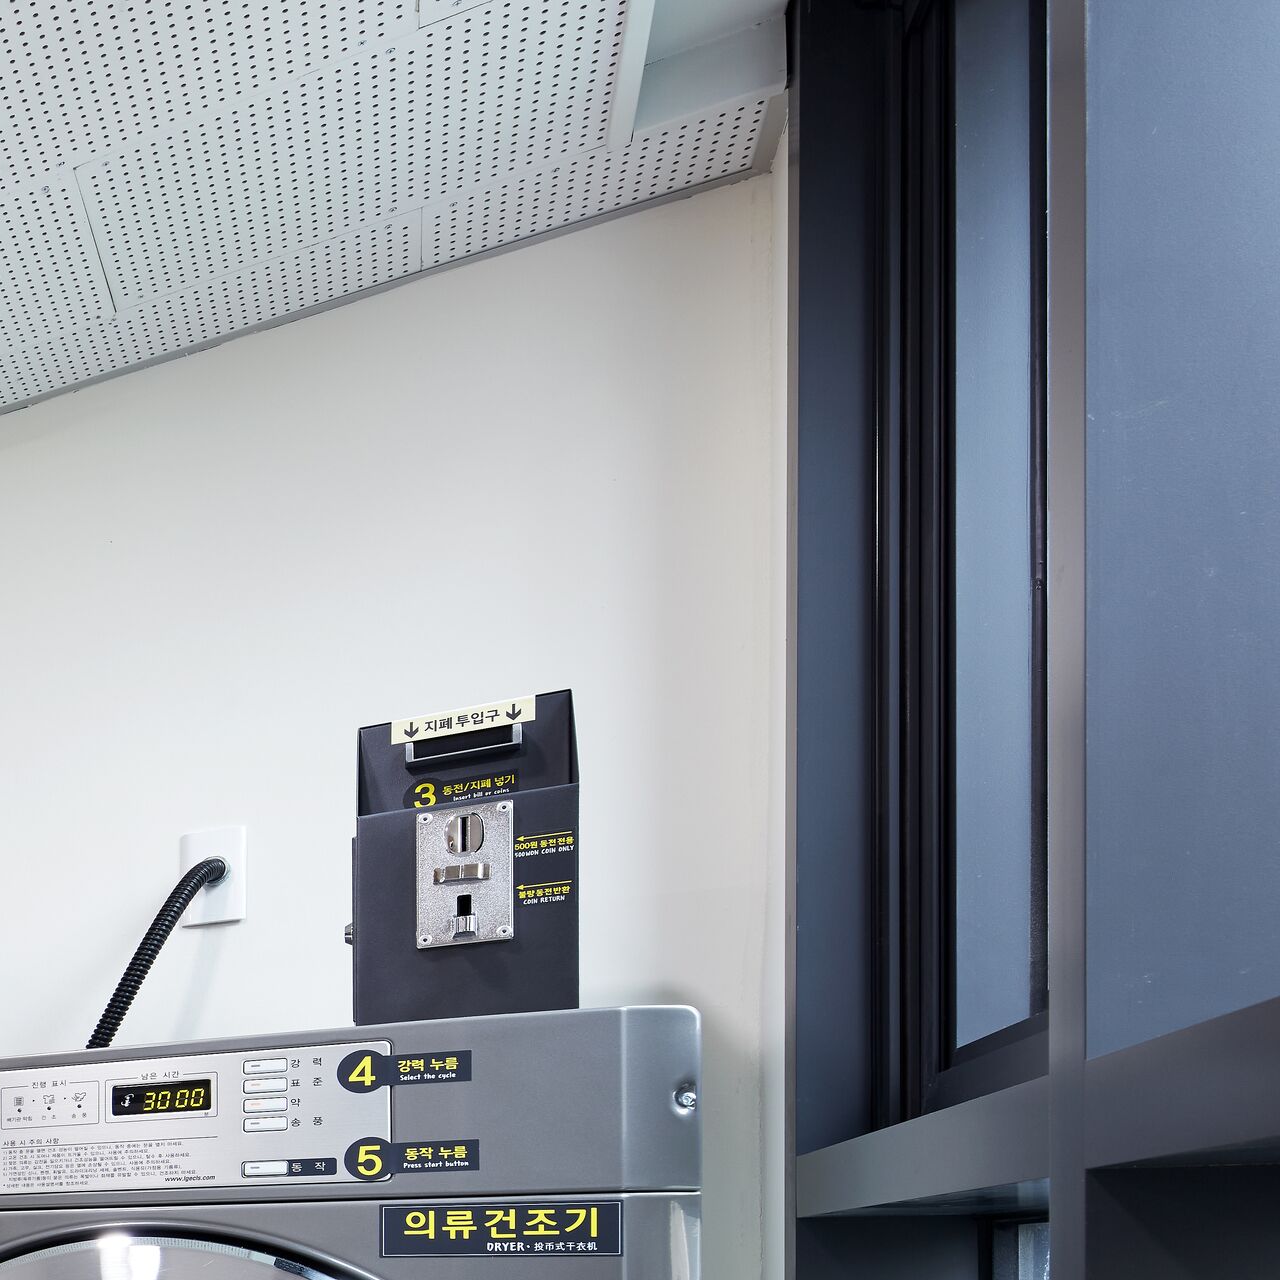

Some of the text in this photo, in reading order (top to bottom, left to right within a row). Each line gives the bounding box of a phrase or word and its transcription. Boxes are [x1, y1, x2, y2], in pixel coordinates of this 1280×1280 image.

[414, 783, 437, 808] 3
[494, 774, 515, 785] 넣기
[541, 847, 556, 856] COIN
[557, 845, 575, 854] ONLY
[523, 895, 566, 905] COIN RETURN
[141, 1071, 179, 1081] 남은 시간
[348, 1056, 458, 1086] 4 강력 누름
[400, 1073, 421, 1081] Select
[438, 1072, 456, 1080] cycle
[52, 1079, 67, 1087] 표시
[357, 1145, 467, 1176] 5 동작 누름
[404, 1207, 598, 1240] 의류건조기
[487, 1242, 524, 1252] DRYER
